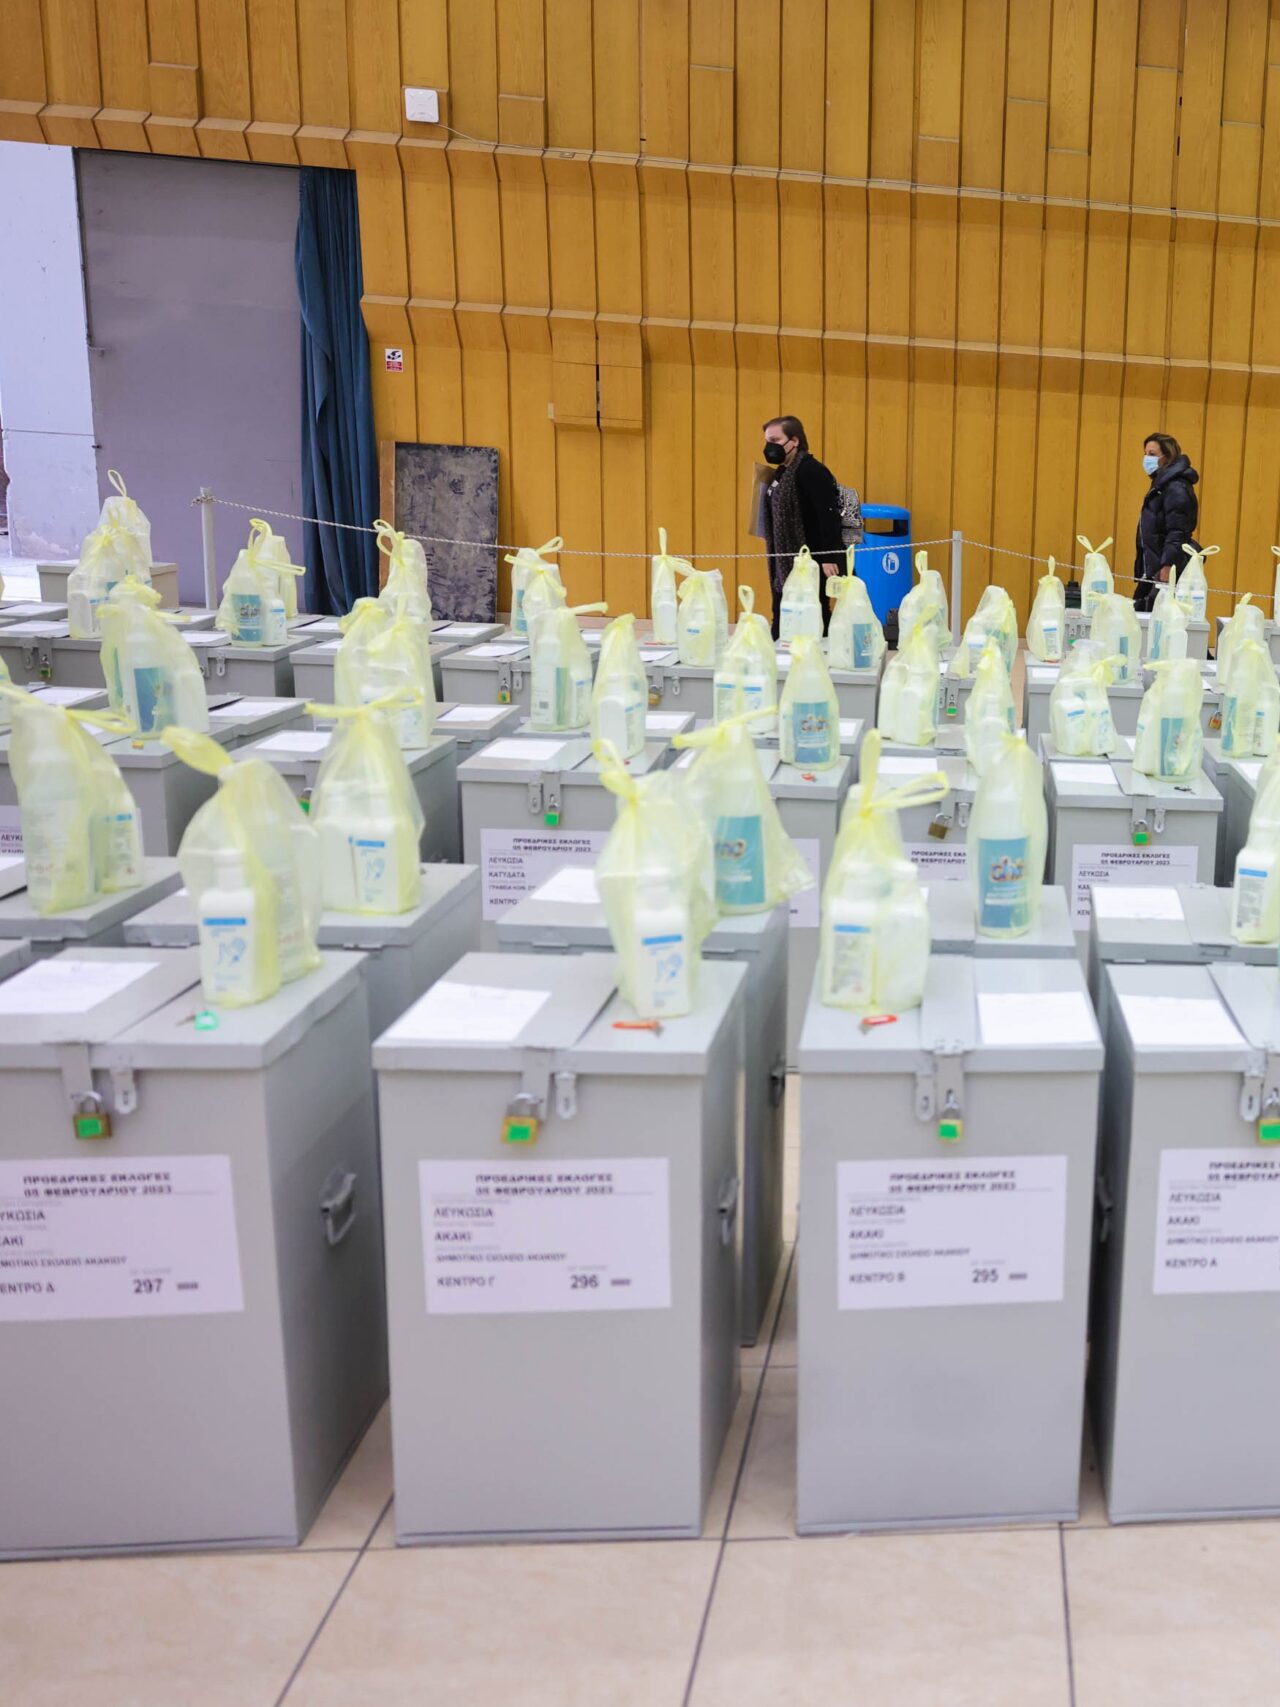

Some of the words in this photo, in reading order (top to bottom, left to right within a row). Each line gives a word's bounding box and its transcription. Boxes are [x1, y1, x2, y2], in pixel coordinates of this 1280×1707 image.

[23, 1174, 105, 1184] ΠΡΟΕΔΡΙΚΕΣ
[110, 1172, 171, 1182] ΕΚΛΟΓΕΣ
[44, 1186, 137, 1197] ΦΕΒΡΟΥΑΡΙΟΥ
[433, 1207, 495, 1218] ΛΕΥΚΩΣΙΑ
[437, 1276, 486, 1287] ΚΕΝΤΡΟ
[570, 1274, 599, 1289] 296
[972, 1268, 999, 1283] 295
[134, 1279, 163, 1295] 297
